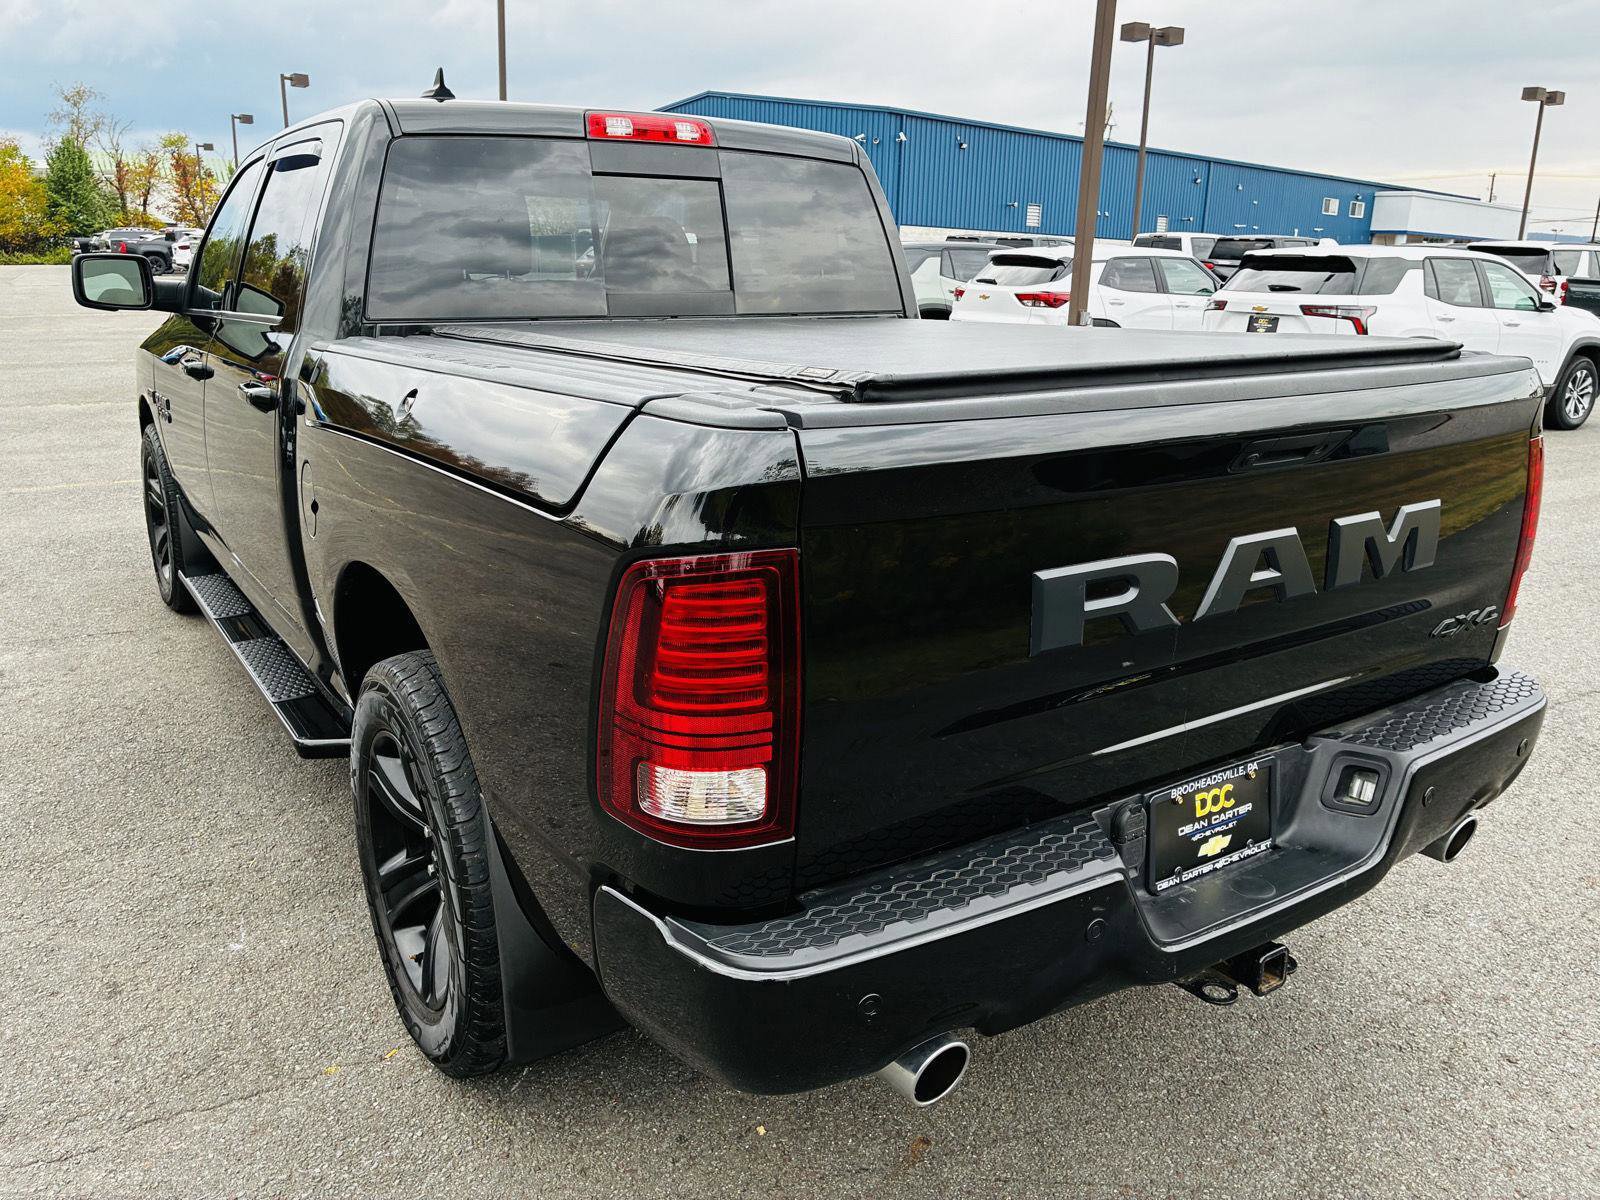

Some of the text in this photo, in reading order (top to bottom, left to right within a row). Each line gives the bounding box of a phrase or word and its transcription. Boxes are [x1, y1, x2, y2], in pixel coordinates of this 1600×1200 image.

[1029, 499, 1441, 657] RAM
[1171, 761, 1259, 799] BRODHEADSVILLE, PA
[1178, 802, 1252, 836] DEAN CARTER
[1197, 820, 1238, 839] CHEVROLET
[1157, 841, 1272, 891] DEAN CARTER CHEVROLET
